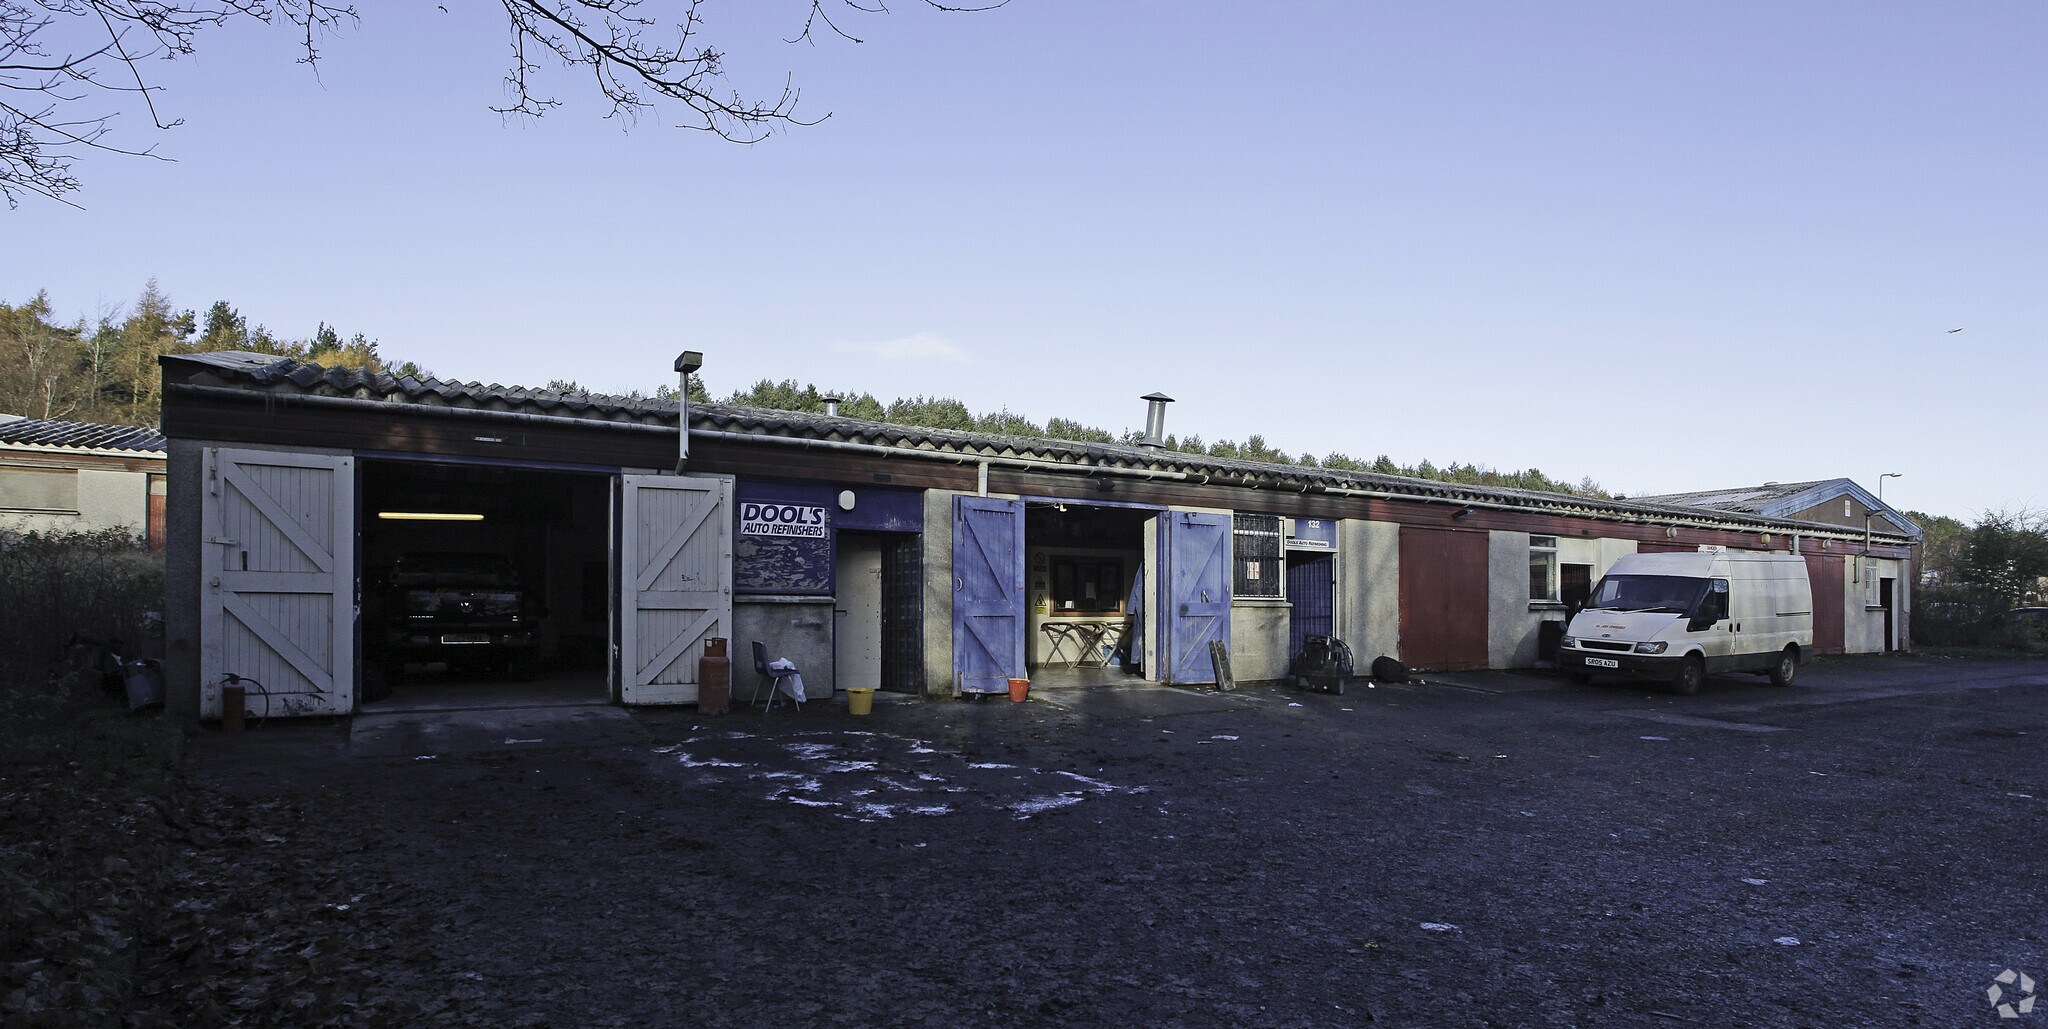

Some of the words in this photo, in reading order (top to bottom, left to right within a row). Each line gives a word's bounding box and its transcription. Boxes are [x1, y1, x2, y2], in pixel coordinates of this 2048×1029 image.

[743, 504, 823, 524] DOOL'S
[743, 522, 770, 534] AUTO
[771, 524, 823, 536] REFINISHERS
[1307, 520, 1320, 528] 132
